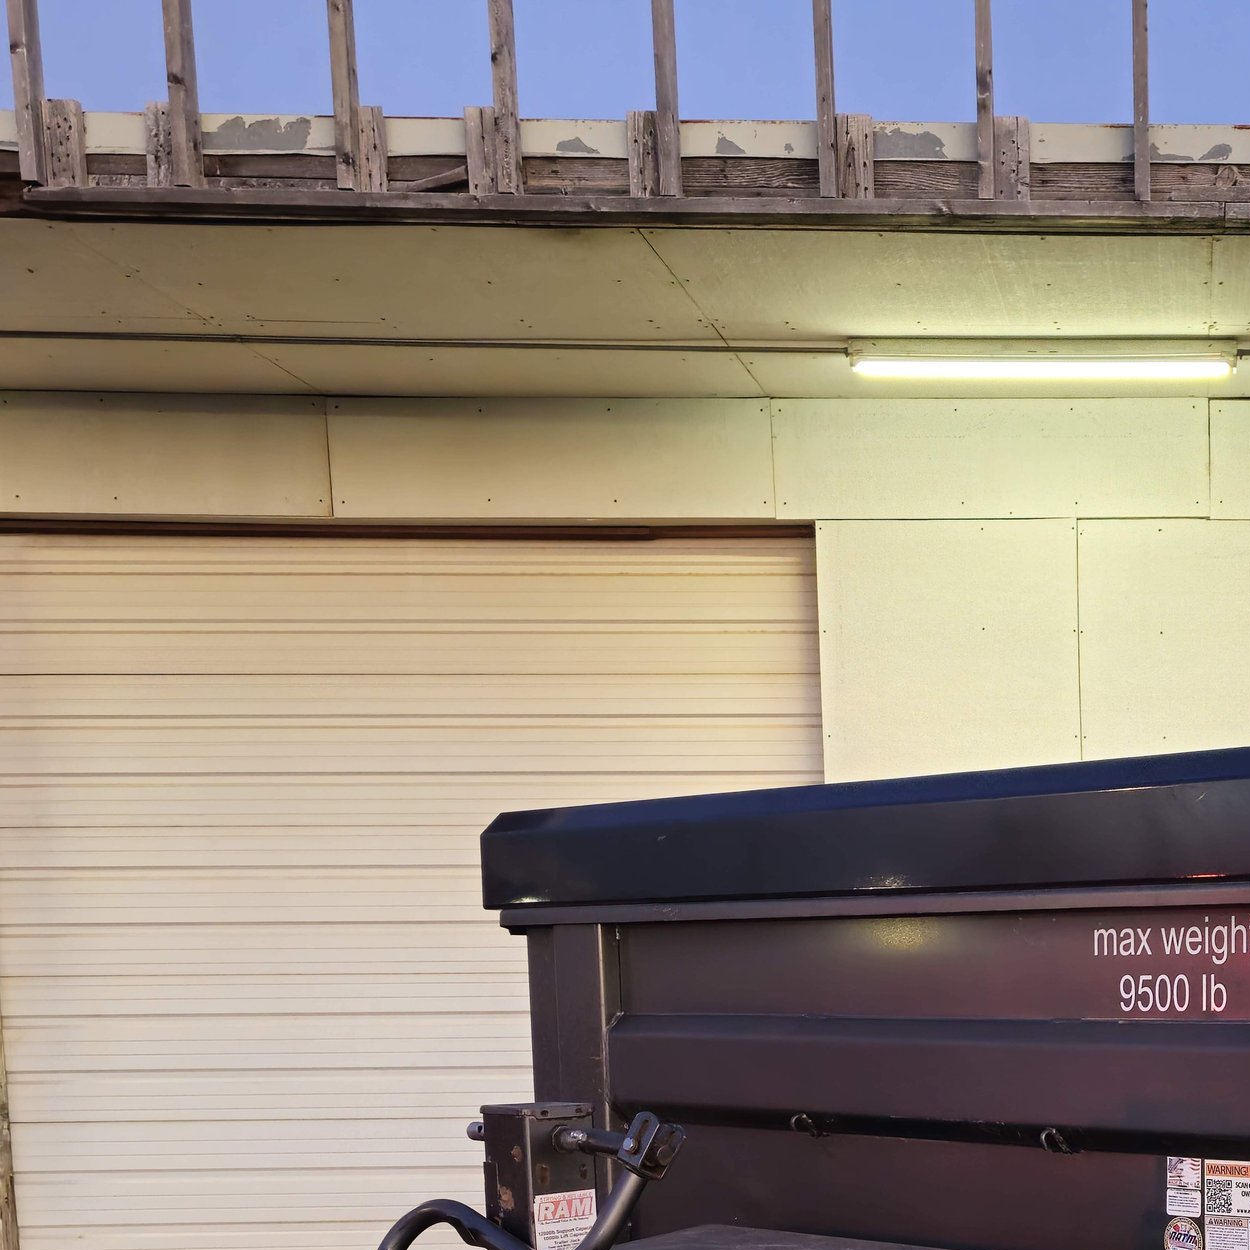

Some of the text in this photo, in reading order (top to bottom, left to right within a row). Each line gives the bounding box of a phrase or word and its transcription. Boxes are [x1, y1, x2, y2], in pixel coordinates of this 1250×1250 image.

[1093, 926, 1152, 956] max
[1119, 973, 1227, 1012] 9500 lb
[1207, 1165, 1249, 1176] WARNING!
[539, 1197, 592, 1220] RAM
[1214, 1218, 1243, 1227] WARNING
